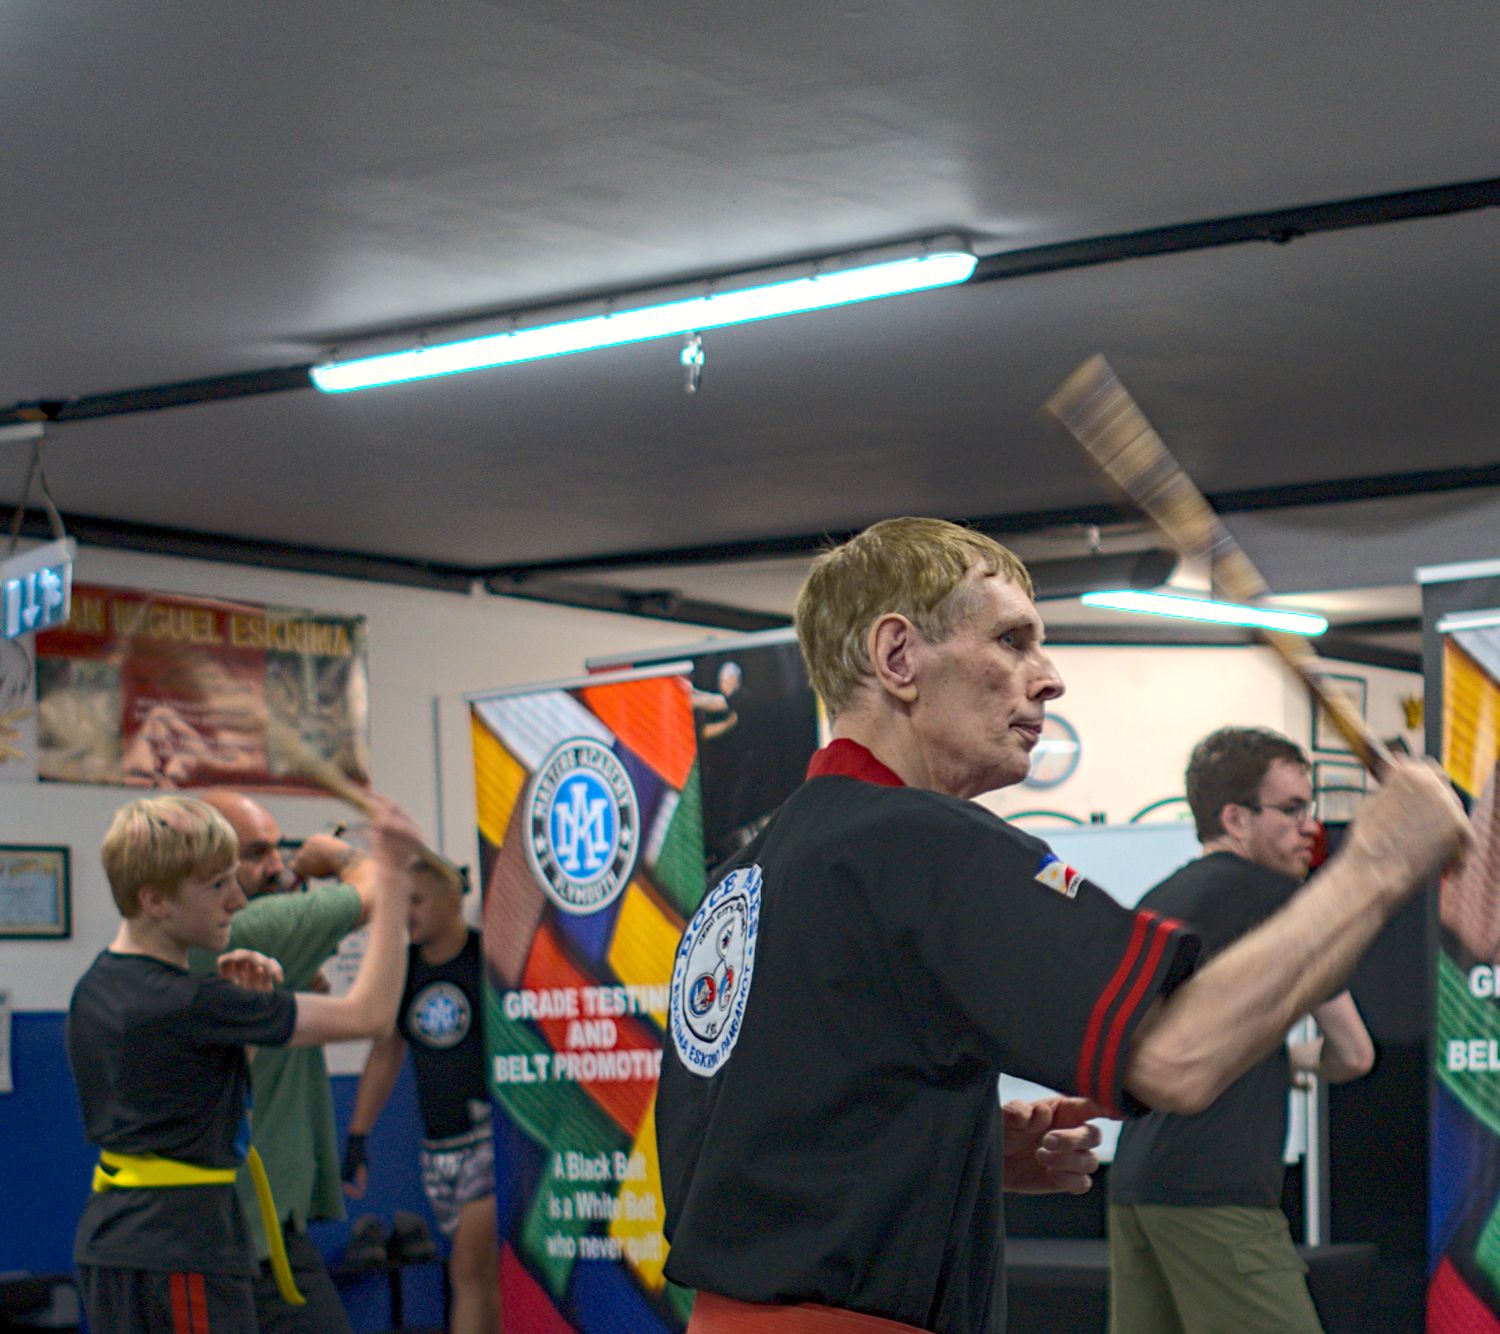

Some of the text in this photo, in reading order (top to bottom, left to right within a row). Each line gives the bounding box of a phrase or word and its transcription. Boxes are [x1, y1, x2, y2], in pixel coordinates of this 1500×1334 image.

[231, 612, 350, 656] ESKRIMA
[681, 872, 738, 956] DOCE
[1469, 965, 1500, 998] G
[503, 988, 579, 1019] GRADE
[581, 985, 670, 1017] TESTIN
[721, 965, 750, 1057] PANGAMOT
[567, 1019, 618, 1049] AND
[493, 1054, 549, 1083] BELT
[554, 1150, 648, 1181] A Black Belt
[547, 1189, 658, 1221] is a White Belt
[545, 1231, 577, 1259] who
[579, 1235, 624, 1260] never
